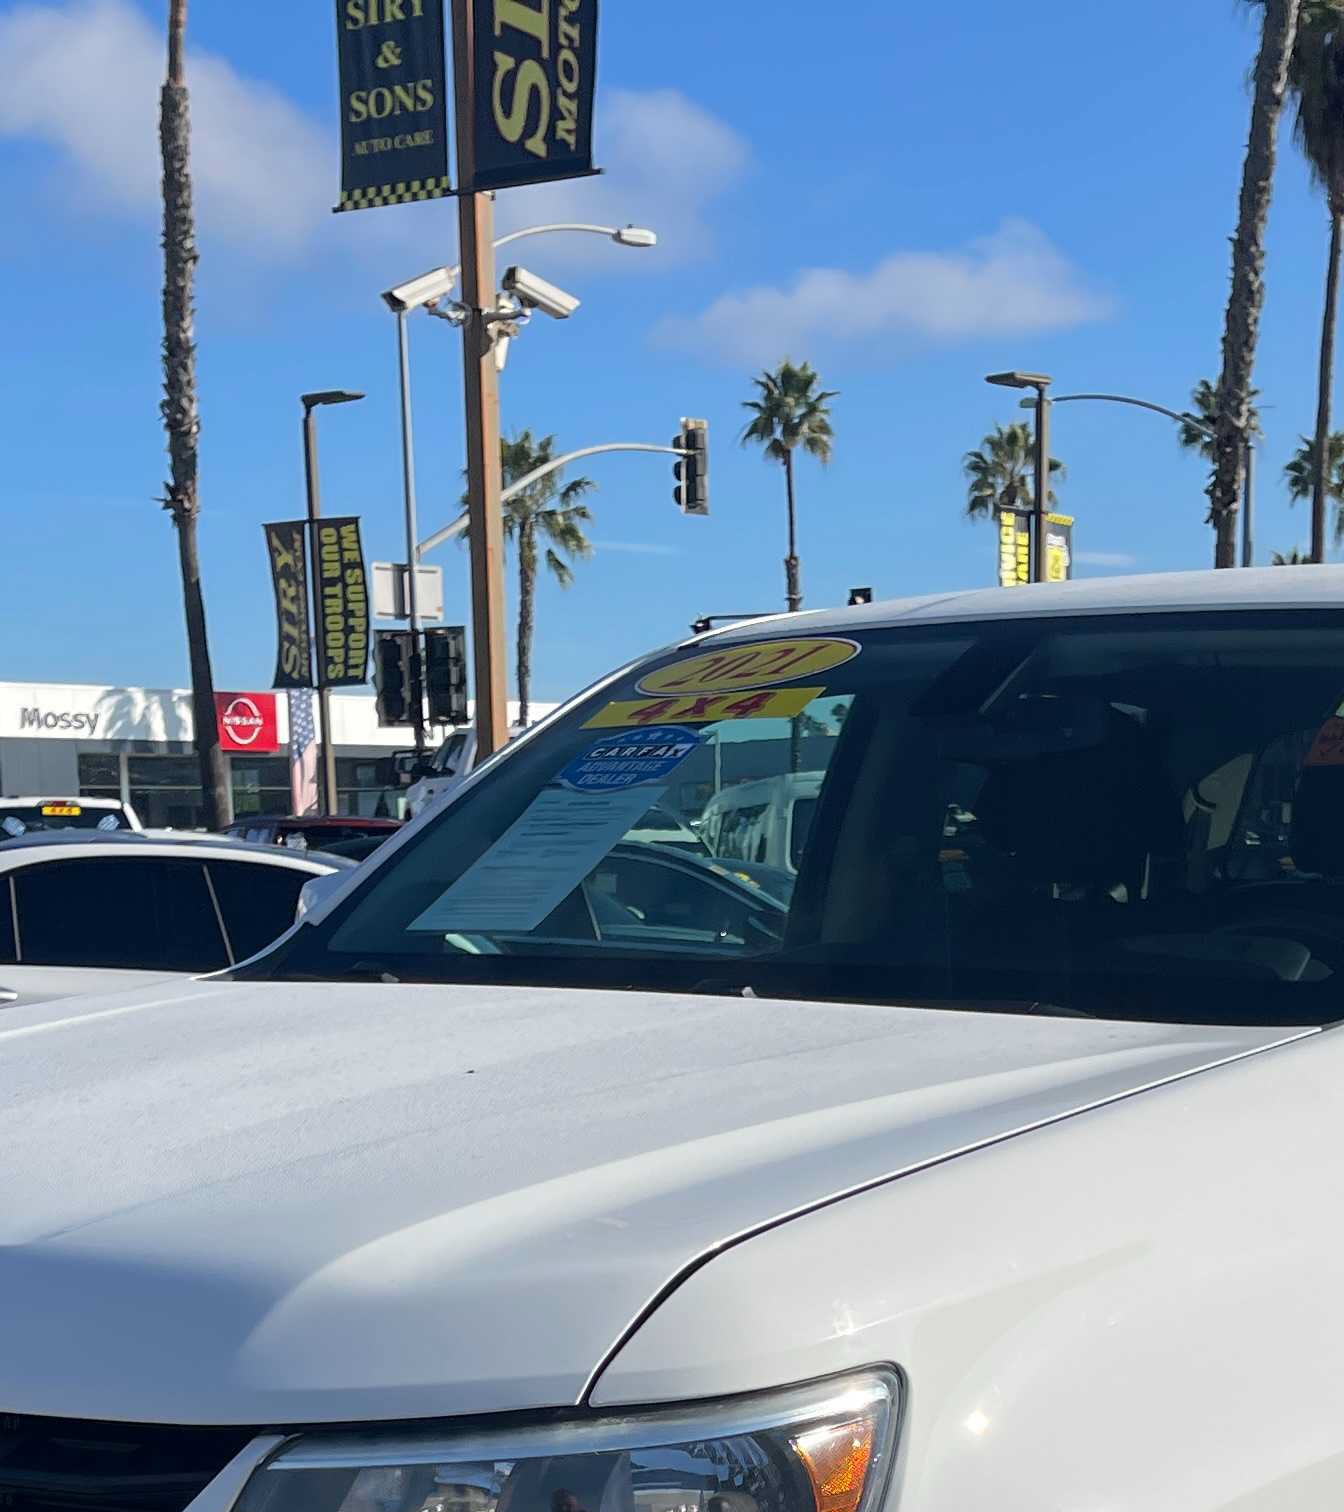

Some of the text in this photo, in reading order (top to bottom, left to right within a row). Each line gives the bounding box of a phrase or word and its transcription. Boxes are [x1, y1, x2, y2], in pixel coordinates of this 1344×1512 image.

[375, 40, 403, 69] &
[348, 79, 435, 123] SONS
[393, 130, 434, 149] CARE
[319, 527, 345, 680] OUR TROOPS
[339, 523, 367, 680] WE SUPPORT
[658, 643, 833, 689] 2021
[19, 706, 100, 736] Mossy
[588, 743, 689, 759] CARFAX
[576, 772, 638, 786] DEALER
